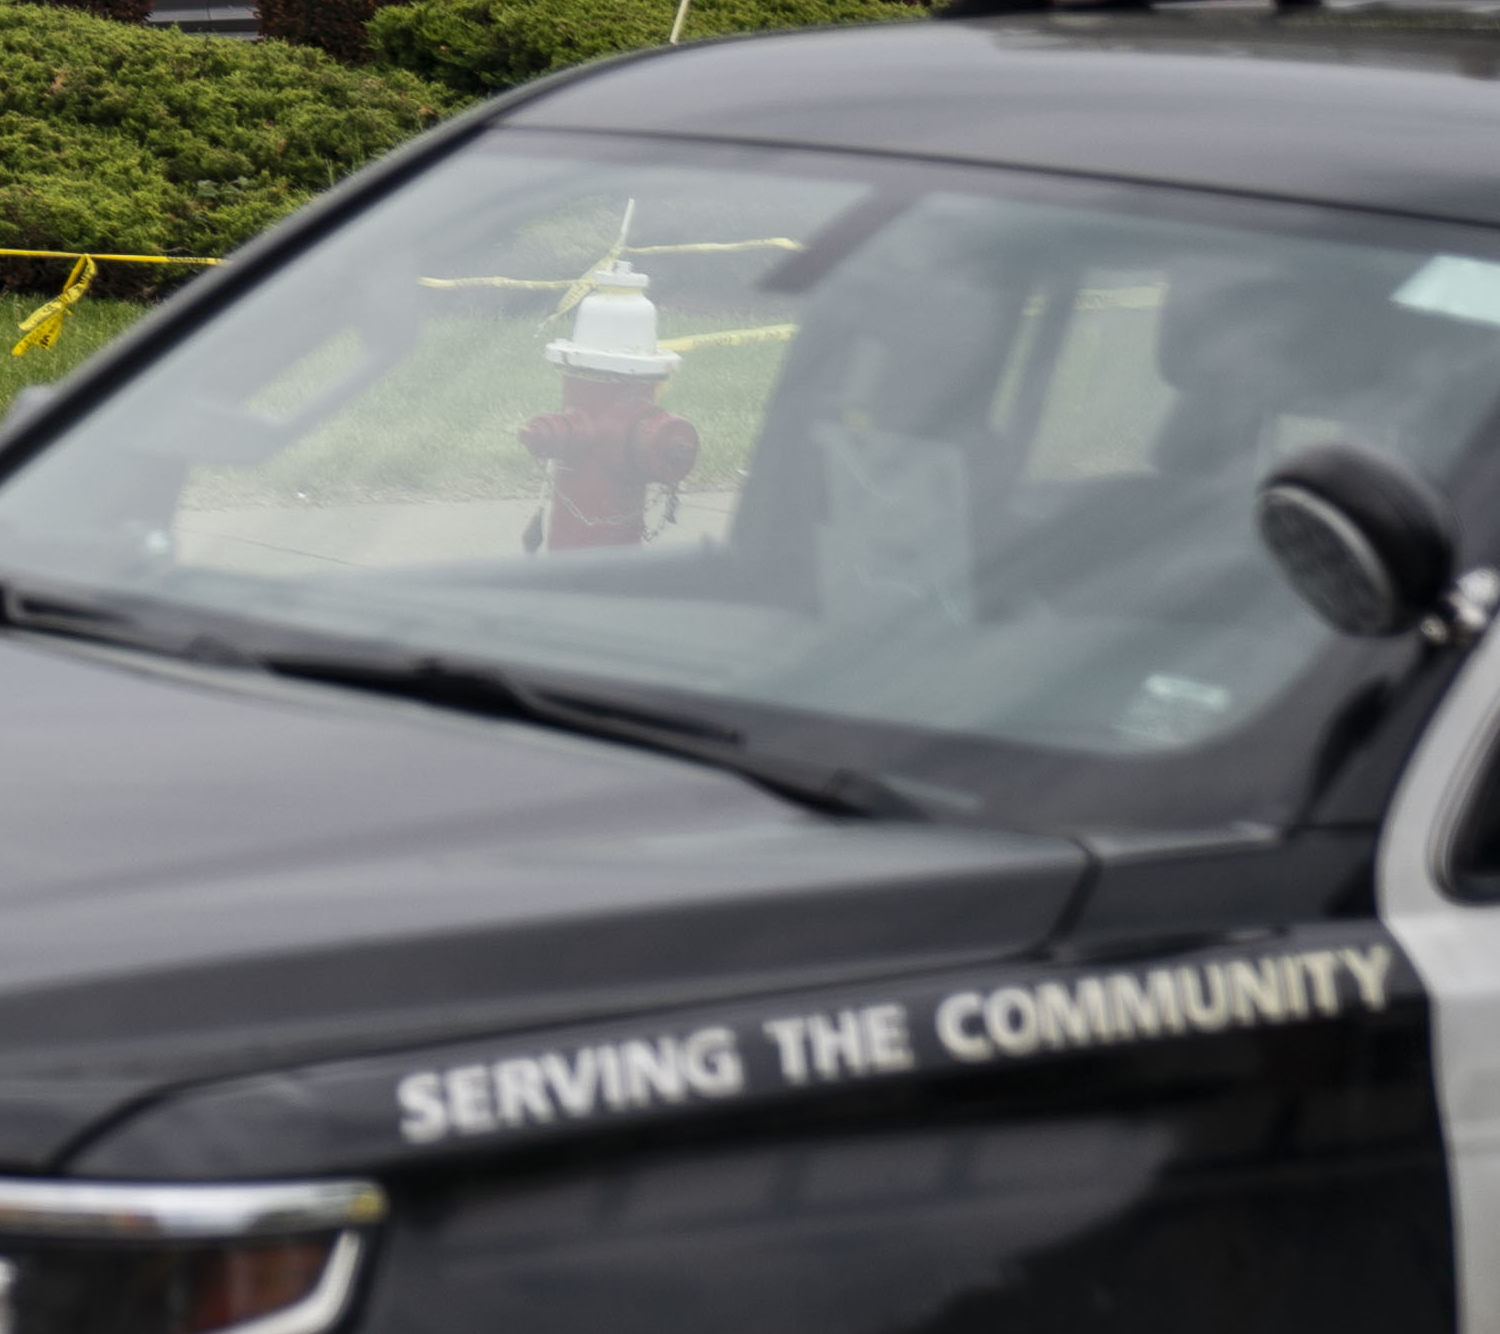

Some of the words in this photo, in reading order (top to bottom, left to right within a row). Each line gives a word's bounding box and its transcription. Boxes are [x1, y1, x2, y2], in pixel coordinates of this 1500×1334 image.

[397, 1026, 743, 1145] SERVING
[764, 1001, 915, 1087] THE
[936, 943, 1397, 1061] COMMUNITY
